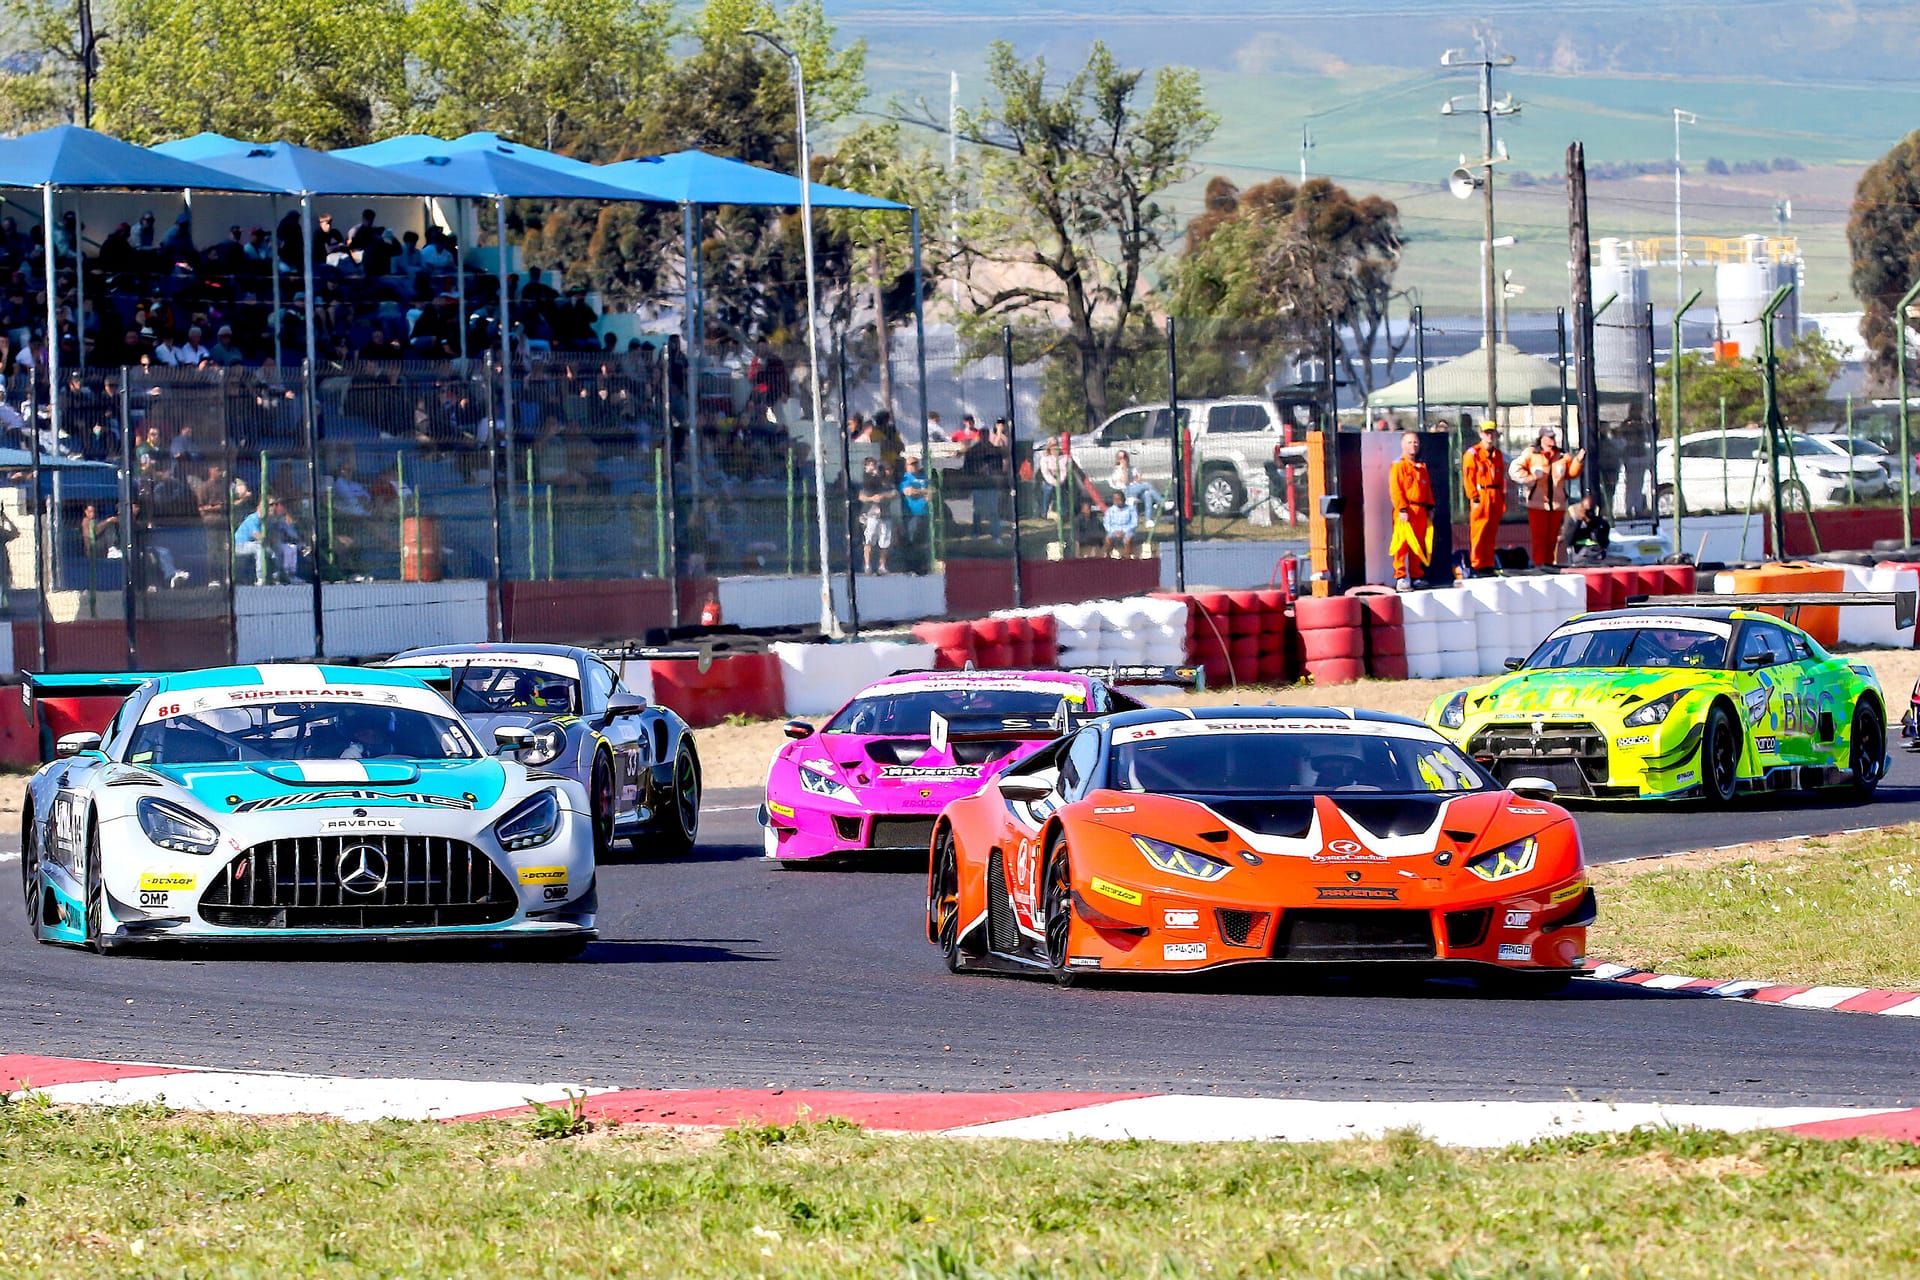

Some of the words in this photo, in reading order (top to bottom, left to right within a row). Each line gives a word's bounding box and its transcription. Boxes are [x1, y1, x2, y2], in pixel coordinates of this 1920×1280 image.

[230, 689, 364, 700] SUPERCARS
[158, 704, 180, 717] 86
[1131, 729, 1157, 739] 34
[626, 748, 638, 777] 33
[328, 819, 396, 828] RAVENOL
[528, 871, 565, 879] DUNLOP
[140, 893, 169, 905] OMP
[1165, 912, 1200, 926] OMP
[1505, 912, 1532, 926] OMP
